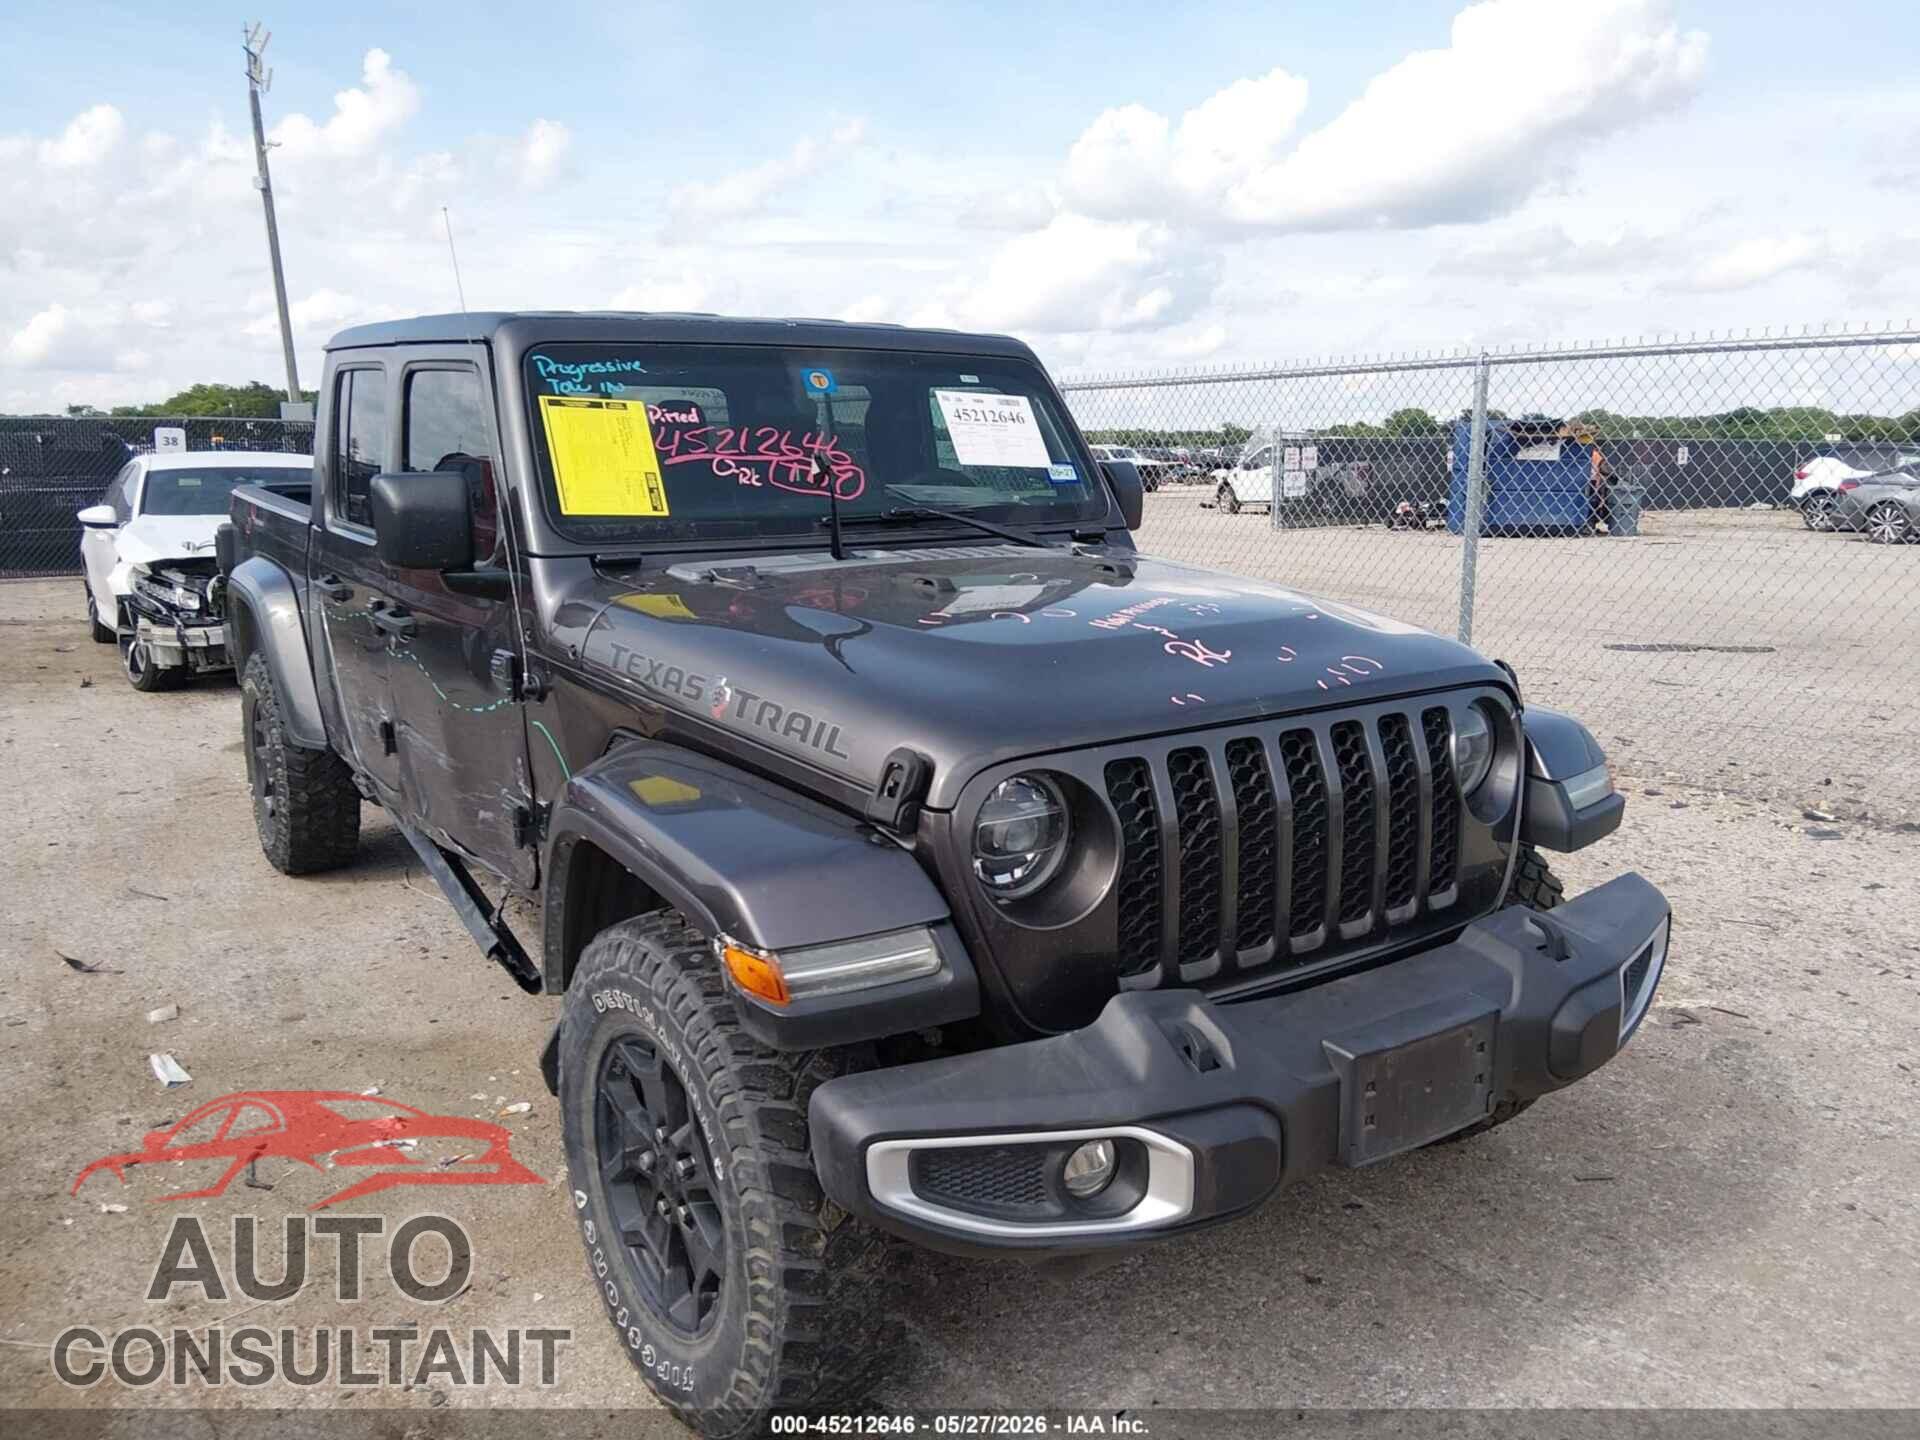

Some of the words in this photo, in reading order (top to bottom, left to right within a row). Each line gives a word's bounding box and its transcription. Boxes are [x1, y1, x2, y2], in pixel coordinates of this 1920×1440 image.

[532, 355, 648, 382] Progressive
[545, 378, 593, 395] Tow
[953, 408, 1026, 425] 45212646
[610, 642, 705, 702] TEXAS
[731, 687, 848, 761] TRAIL
